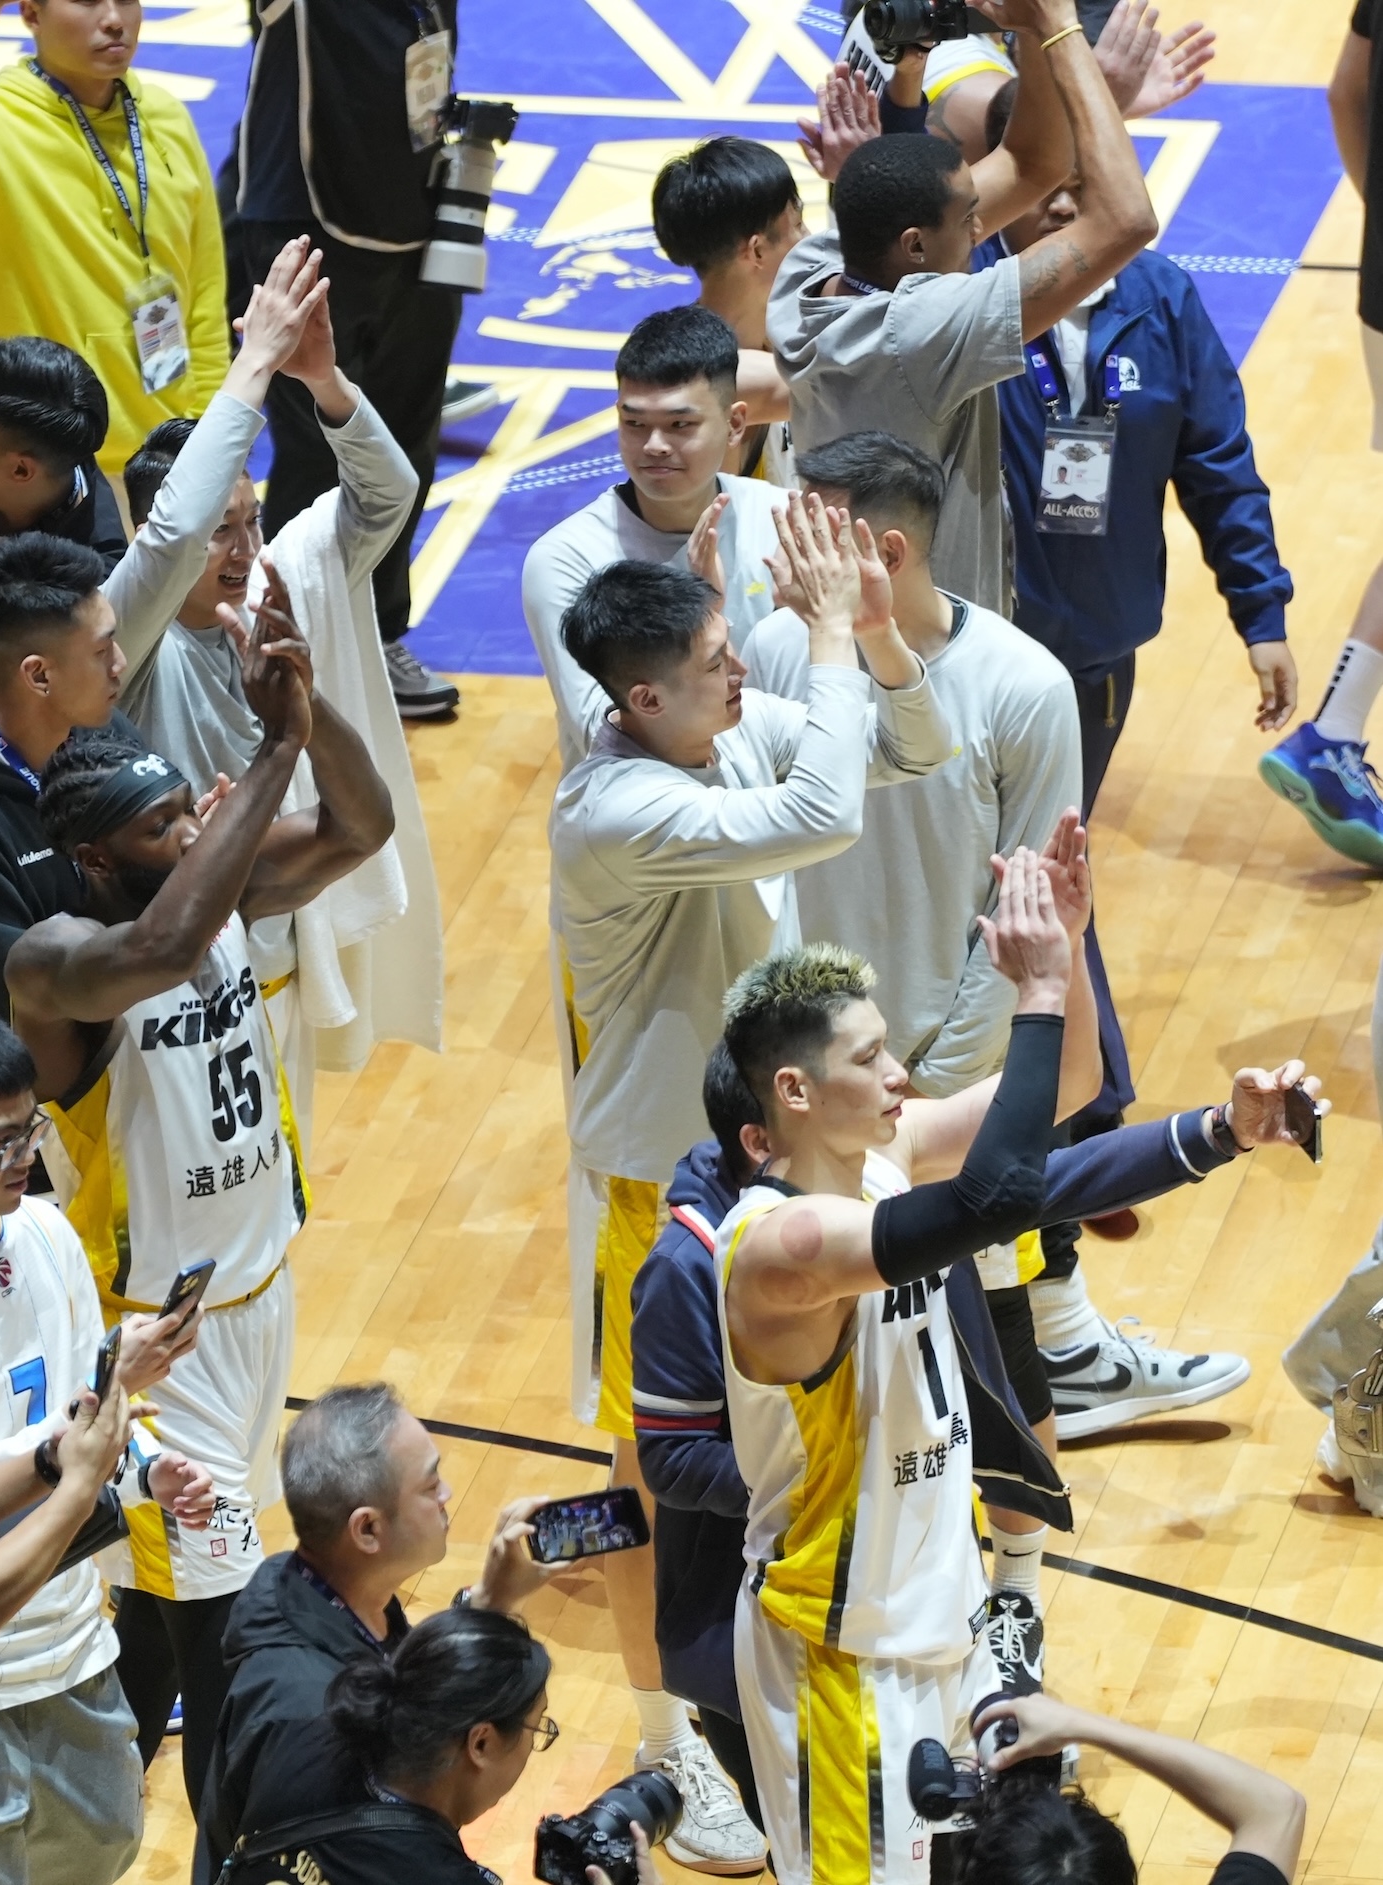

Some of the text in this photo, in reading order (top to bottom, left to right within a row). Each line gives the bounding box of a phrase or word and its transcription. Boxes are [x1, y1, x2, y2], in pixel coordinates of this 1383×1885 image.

[130, 123, 140, 149] ASIA
[134, 149, 148, 182] SUPER
[1118, 379, 1142, 391] ASL
[1043, 502, 1100, 519] ALL-ACCESS
[140, 966, 256, 1050] KINGS
[208, 1040, 263, 1143] 55
[8, 1355, 47, 1427] 7
[916, 1326, 949, 1420] 1
